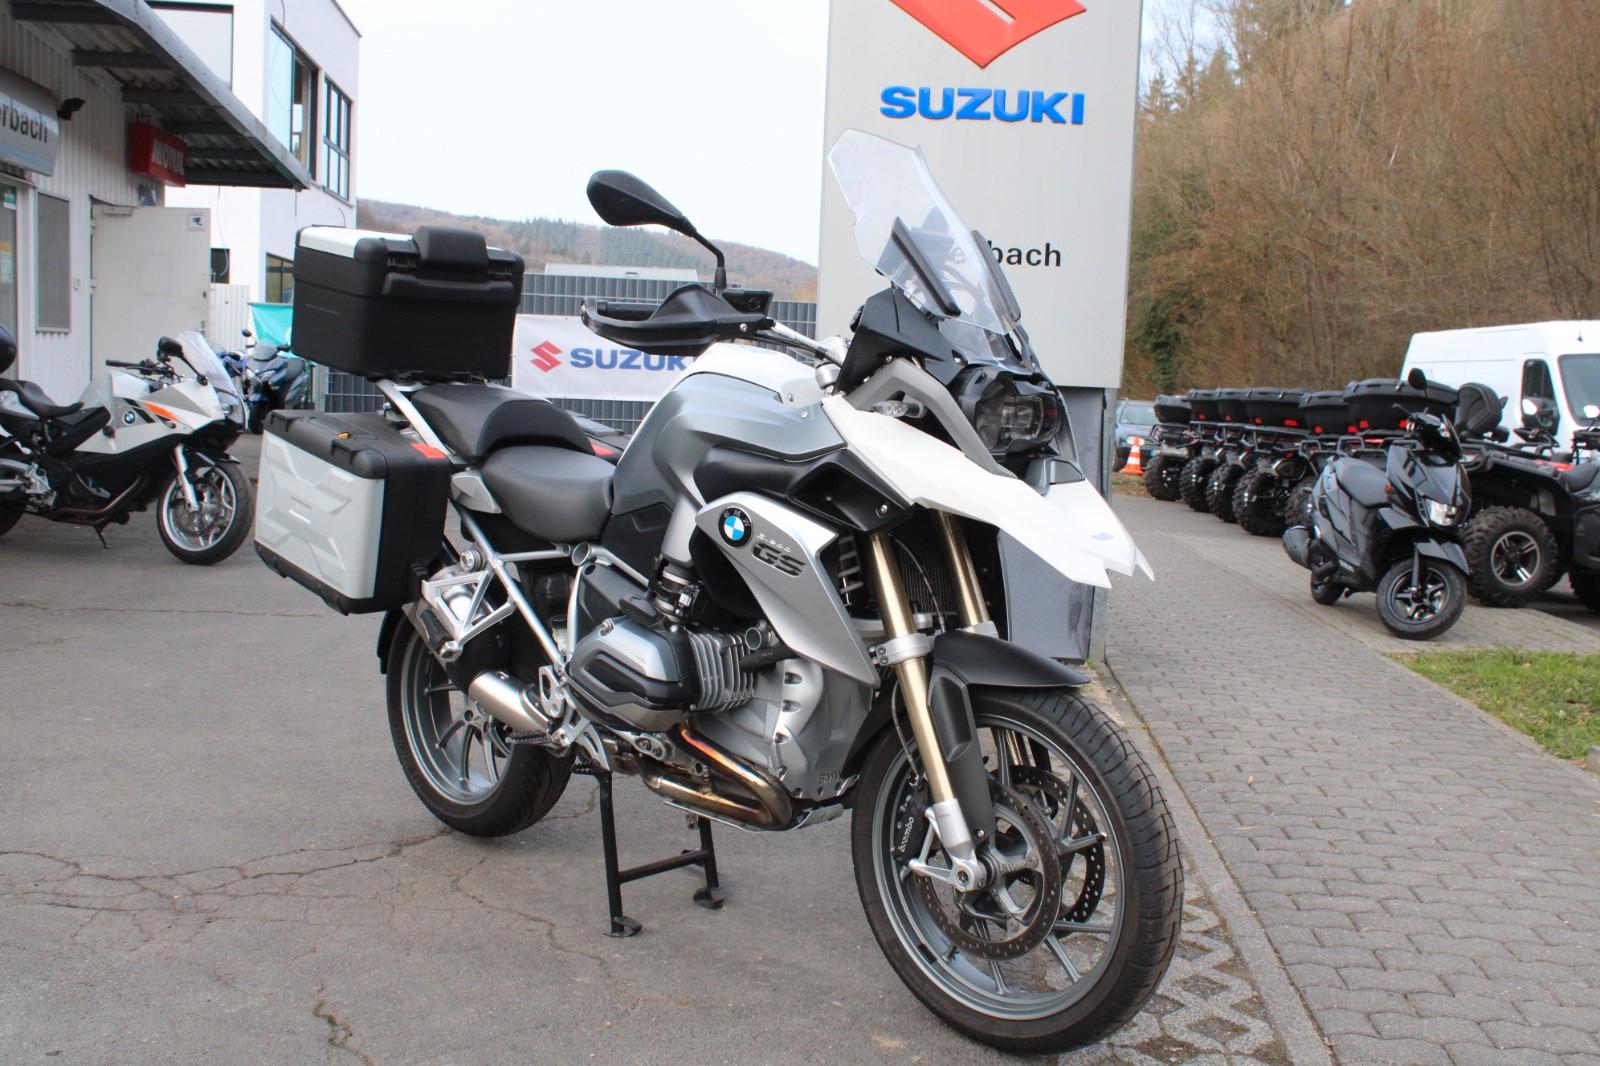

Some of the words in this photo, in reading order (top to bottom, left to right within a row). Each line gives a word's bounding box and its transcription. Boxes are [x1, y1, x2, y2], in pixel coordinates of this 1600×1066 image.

[0, 99, 48, 144] rbach
[880, 85, 1085, 126] SUZUKI
[570, 347, 698, 371] SUZUK
[752, 542, 806, 576] GS
[898, 816, 914, 852] brembo
